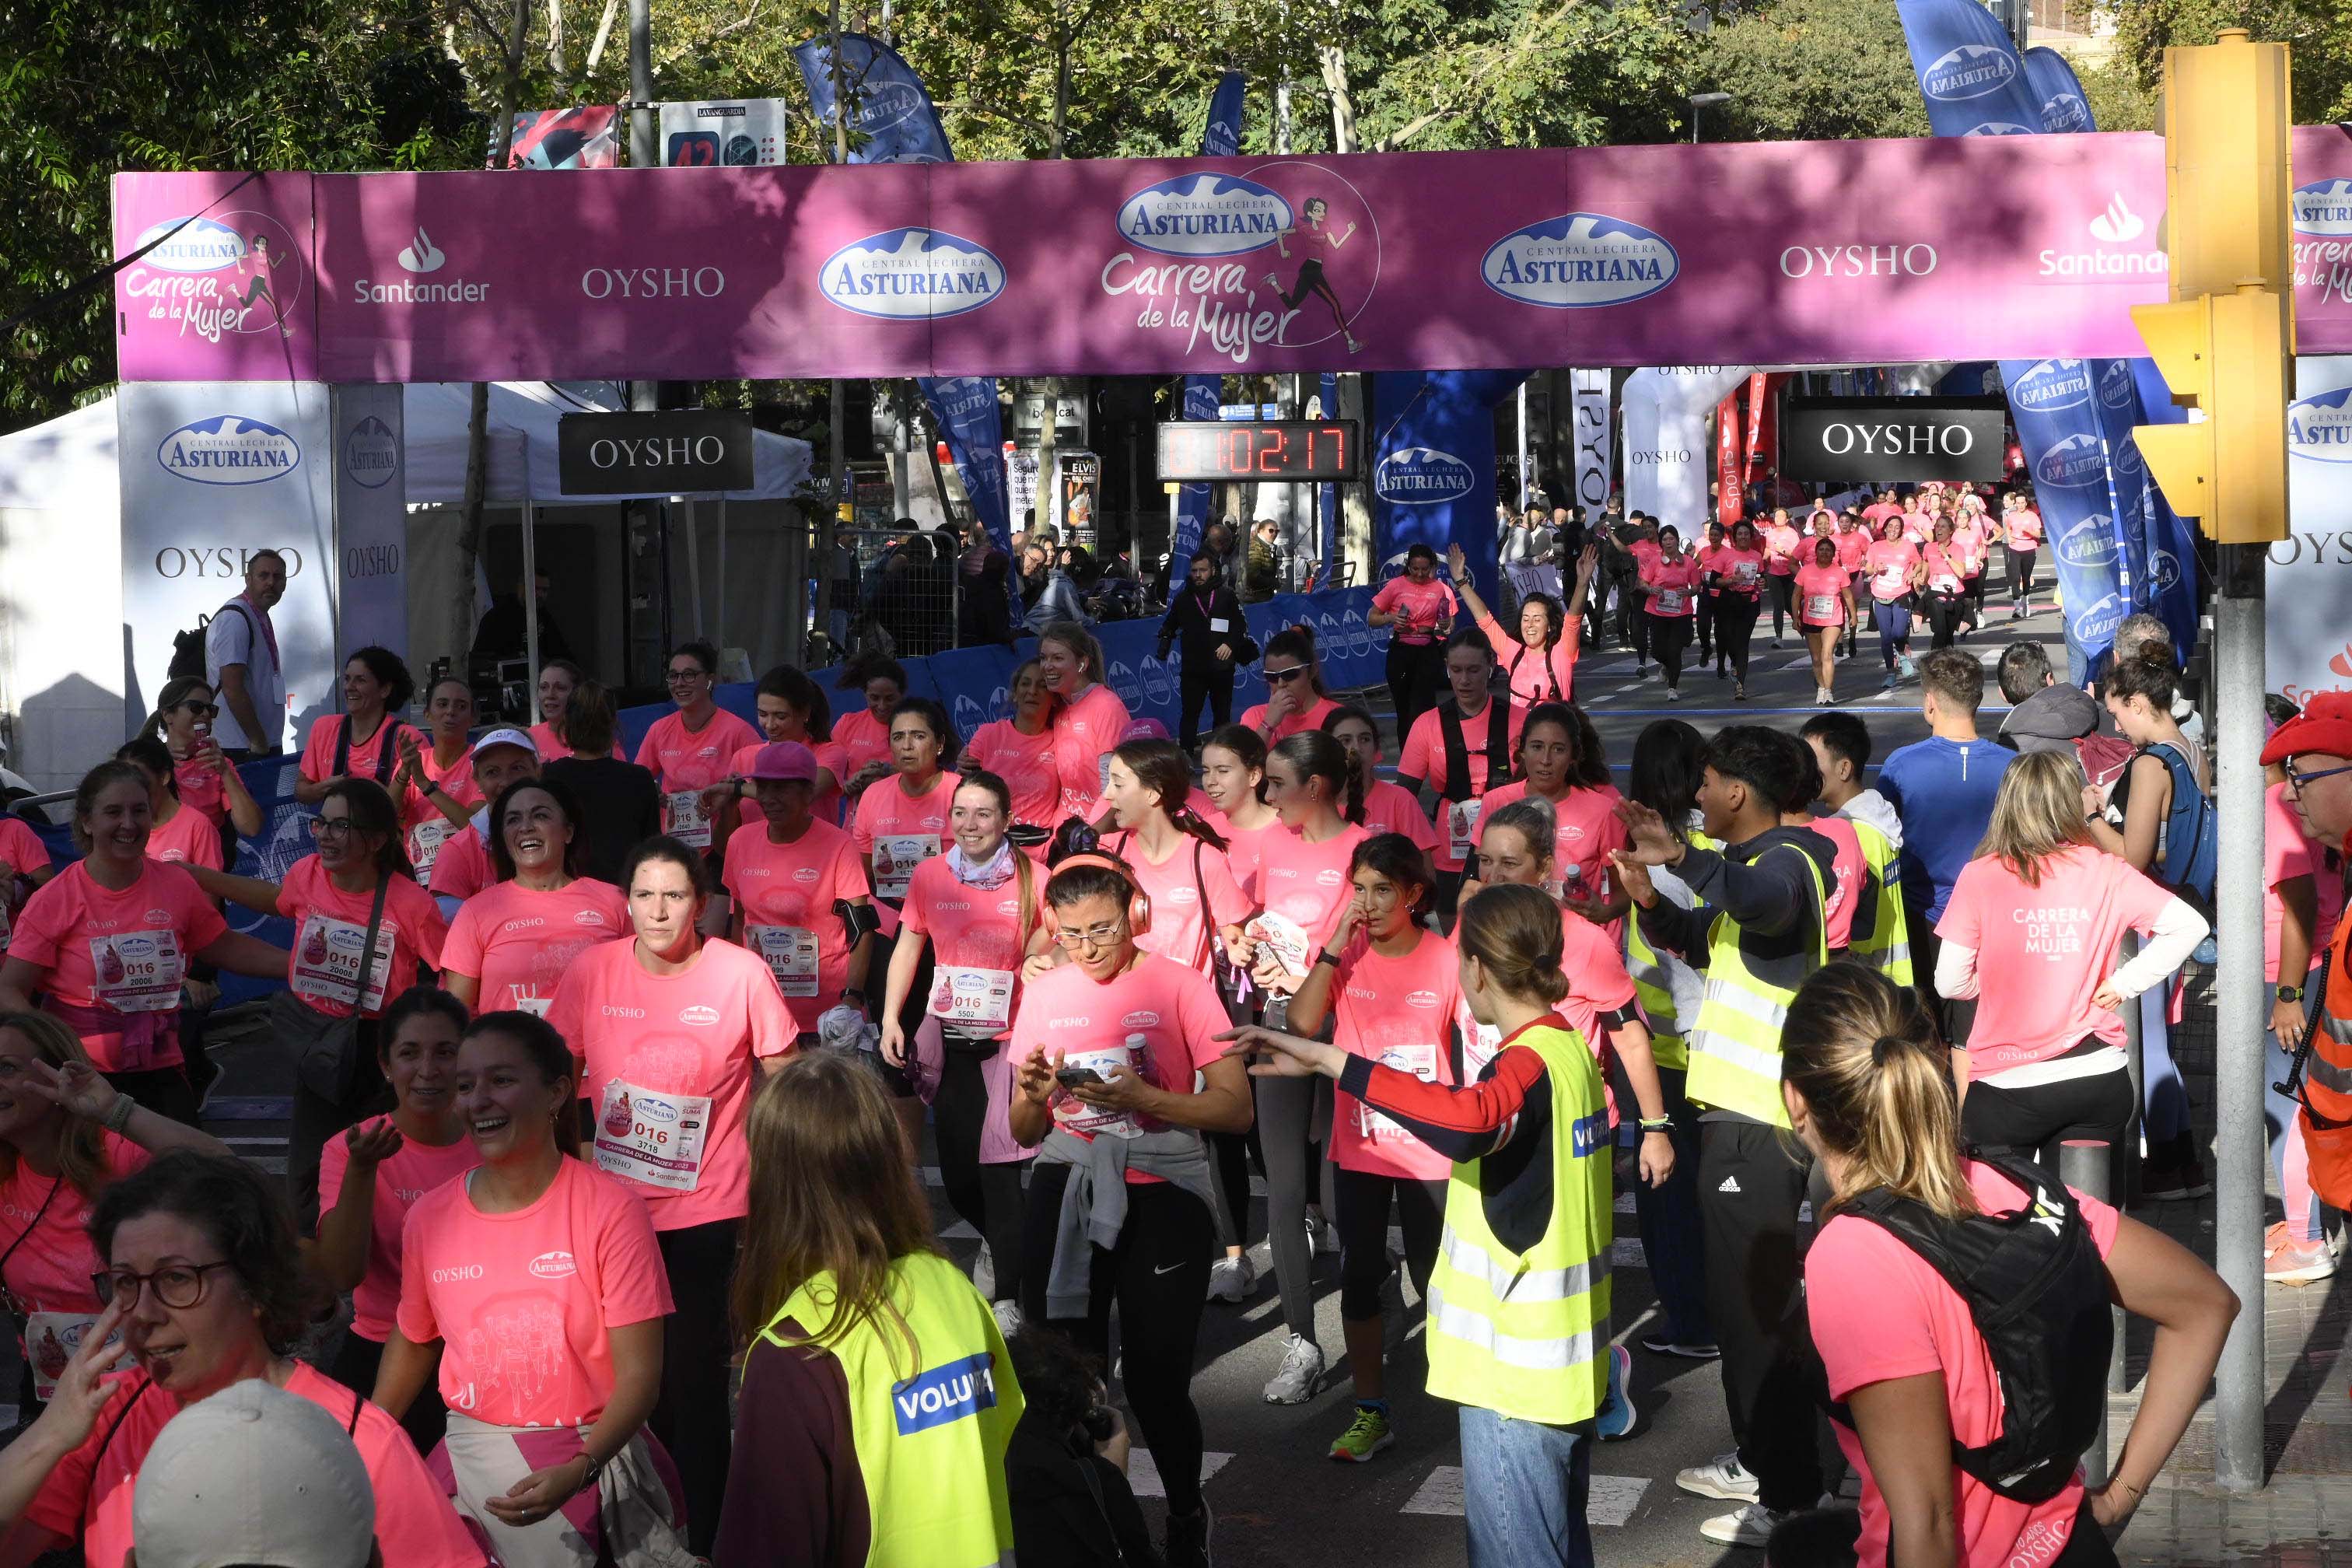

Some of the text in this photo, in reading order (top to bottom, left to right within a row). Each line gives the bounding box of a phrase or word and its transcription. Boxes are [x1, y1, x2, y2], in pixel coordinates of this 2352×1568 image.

[1157, 199, 1274, 210] CENTRAL LECHERA
[1131, 204, 1279, 236] ASTURIANA
[1527, 245, 1657, 257] CENTRAL LECHERA
[862, 257, 985, 268] CENTRAL LECHERA
[1496, 250, 1664, 285] ASTURIANA
[1780, 243, 1937, 278] OYSHO
[125, 268, 218, 298] Carrera
[582, 267, 725, 298] OYSHO
[833, 261, 991, 296] ASTURIANA
[1101, 252, 1247, 297] Carrera
[355, 278, 490, 303] Santander
[149, 295, 253, 343] de la Mujer
[1137, 289, 1301, 363] de la Mujer
[2310, 414, 2352, 423] CENTRA
[1577, 367, 1606, 506] OYSH
[1822, 423, 1972, 456] OYSHO
[169, 441, 290, 467] ASTURIANA
[590, 436, 725, 468] OYSHO
[1633, 449, 1692, 465] OYSHO
[1379, 471, 1468, 492] ASTURIANA
[2269, 531, 2352, 566] OYS
[347, 544, 398, 579] OYSHO
[677, 814, 691, 822] 016
[424, 845, 439, 856] 016
[896, 859, 918, 868] 016
[936, 901, 971, 910] OYSHO
[2013, 908, 2091, 923] CARRERA
[505, 917, 544, 932] OYSHO
[2028, 922, 2077, 938] DE LA
[121, 945, 155, 954] ASTURIANA
[2025, 937, 2081, 953] MUJER
[328, 951, 359, 969] 016
[765, 954, 791, 964] 016
[126, 961, 155, 975] 016
[329, 965, 353, 978] 20008
[130, 978, 153, 986] 20006
[300, 980, 327, 992] OYSHO
[509, 982, 537, 1000] TU
[954, 996, 981, 1008] 016
[602, 1005, 645, 1018] OYSHO
[636, 1101, 675, 1120] ASTURIANA
[635, 1122, 668, 1144] 016
[637, 1139, 658, 1154] 3718
[600, 1153, 632, 1170] OYSHO
[606, 1143, 634, 1157] CARRERA
[635, 1150, 642, 1159] DE
[644, 1153, 652, 1162] LA
[653, 1156, 674, 1169] MUJER
[656, 1171, 689, 1184] Santander
[432, 1264, 484, 1283] OYSHO
